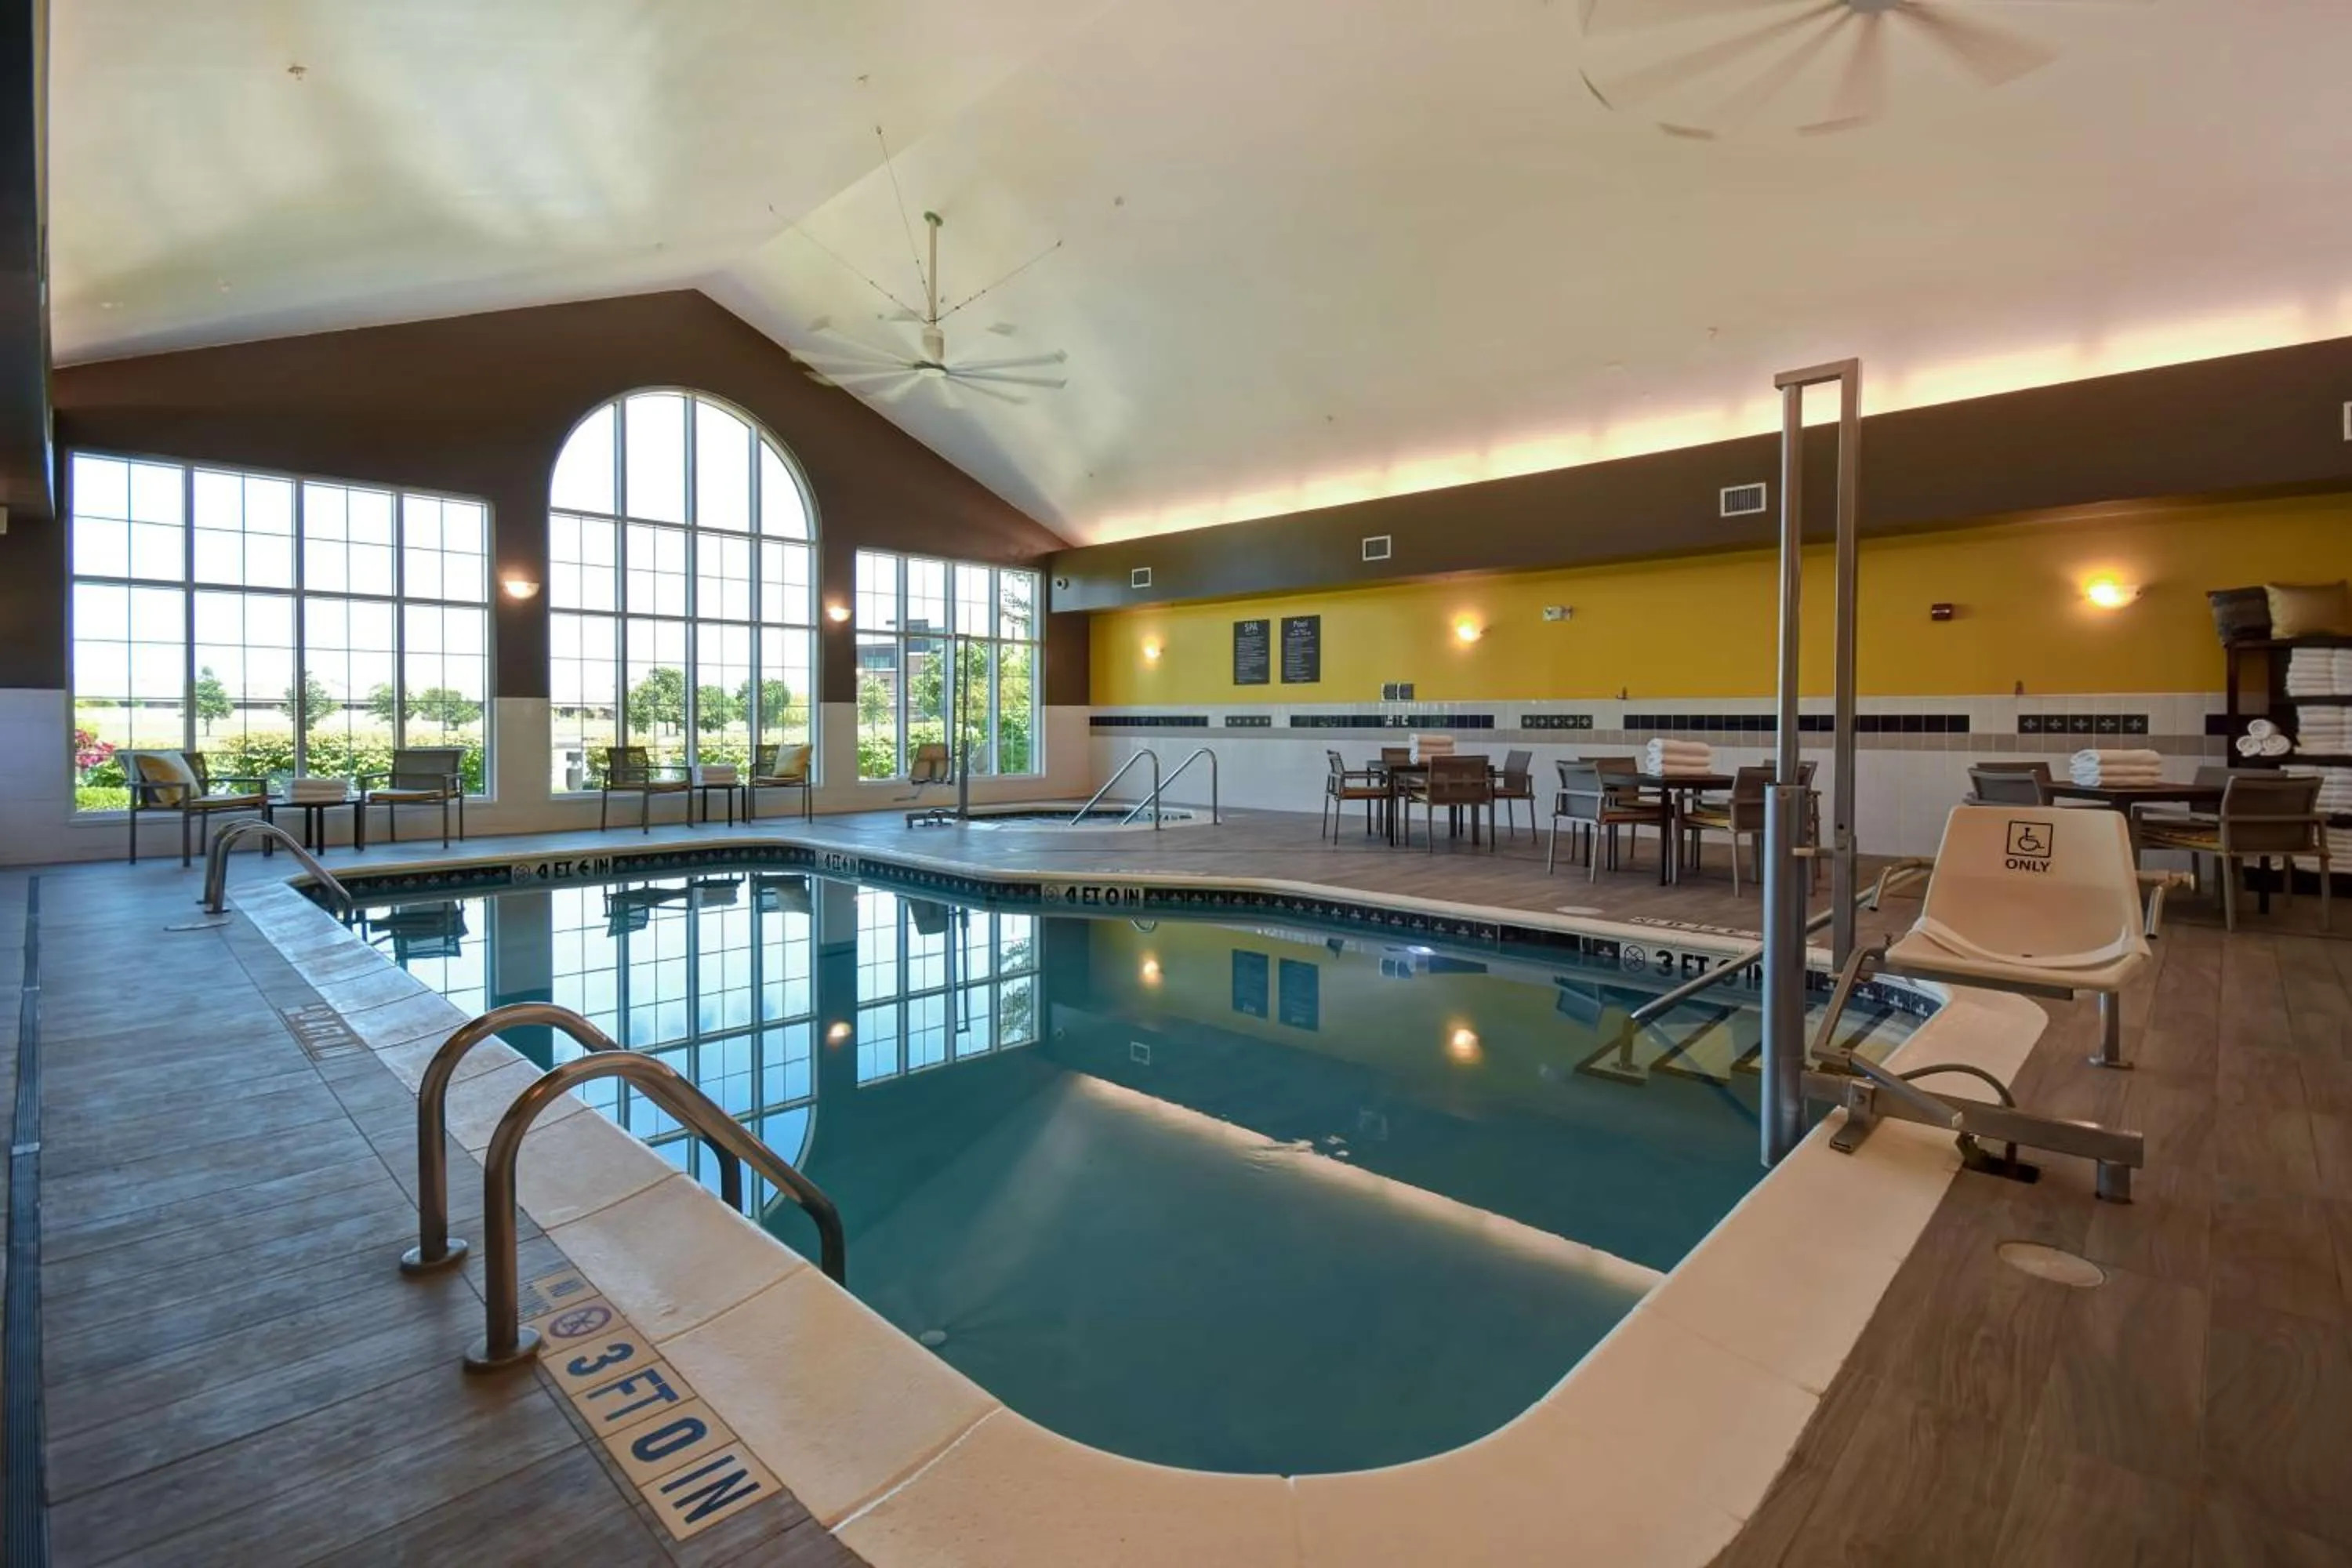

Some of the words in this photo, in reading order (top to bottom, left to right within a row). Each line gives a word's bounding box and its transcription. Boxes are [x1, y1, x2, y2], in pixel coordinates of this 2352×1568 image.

[1244, 622, 1259, 633] SPA
[2005, 858, 2051, 873] ONLY
[1681, 953, 1710, 976] FT
[566, 1342, 634, 1377] 3
[586, 1367, 679, 1421] FT
[660, 1454, 760, 1524] IN
